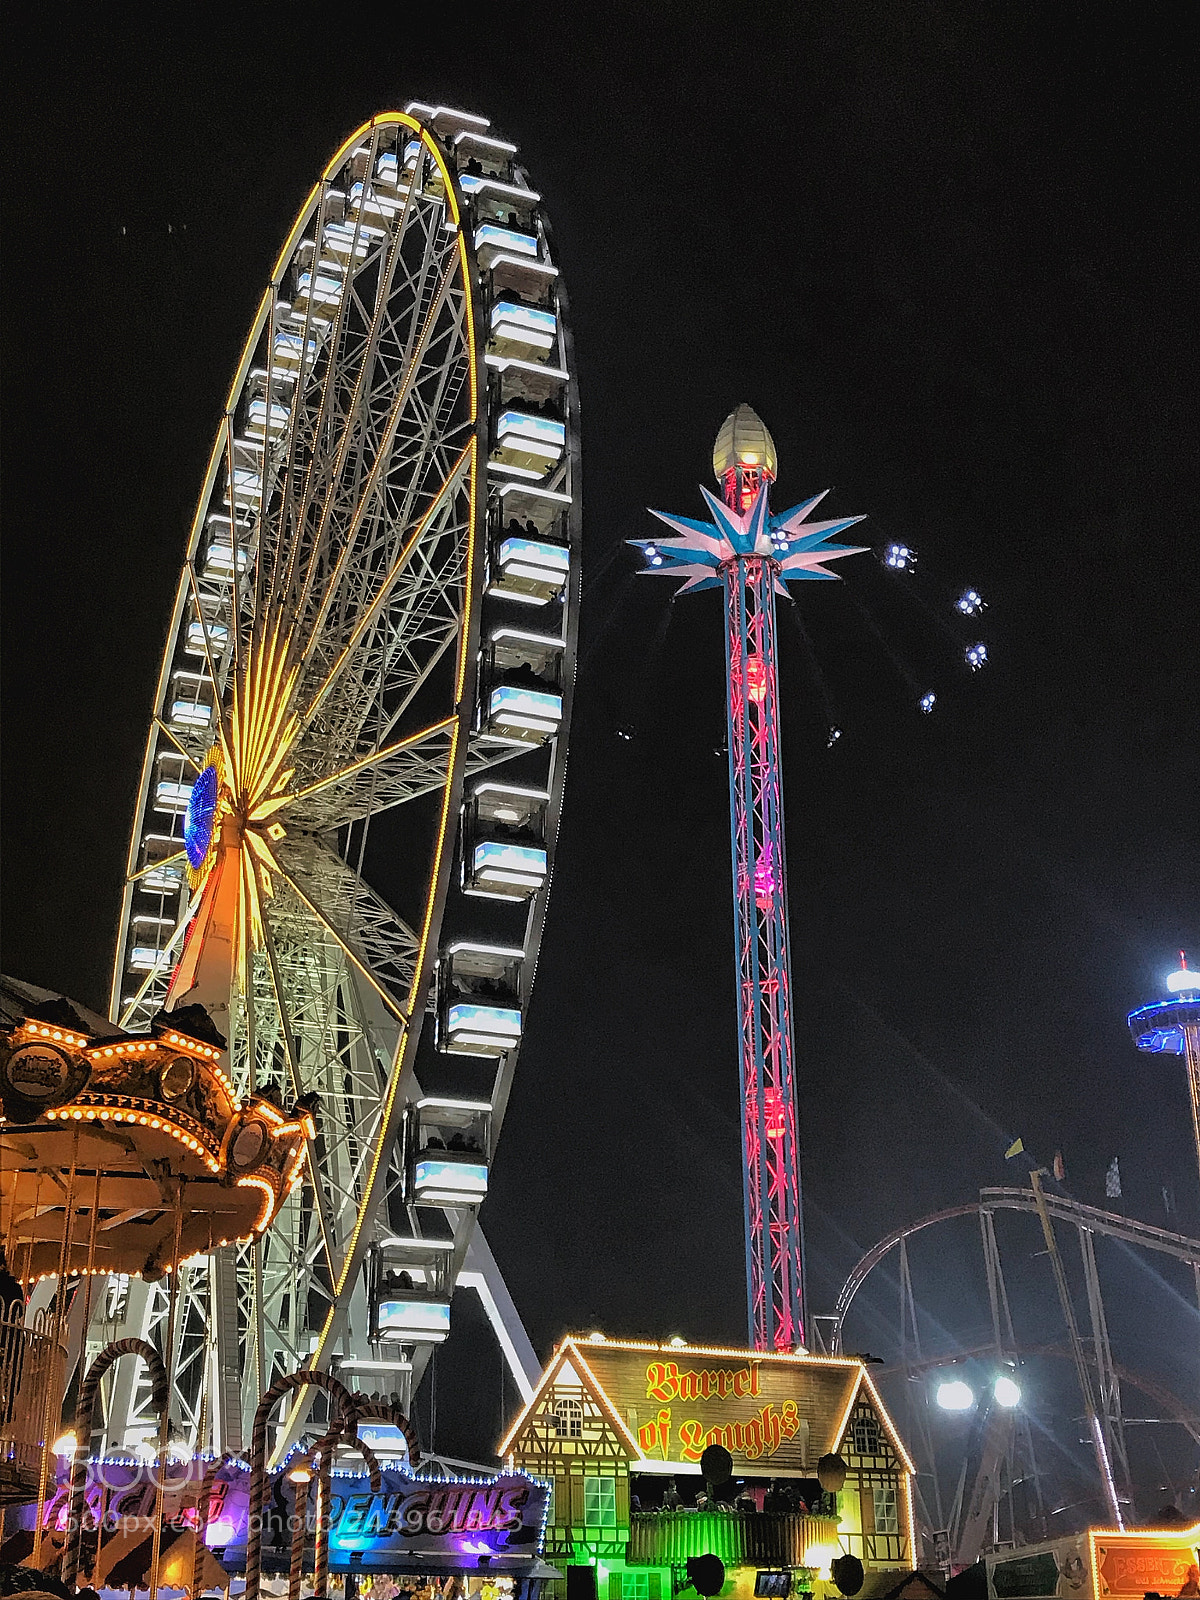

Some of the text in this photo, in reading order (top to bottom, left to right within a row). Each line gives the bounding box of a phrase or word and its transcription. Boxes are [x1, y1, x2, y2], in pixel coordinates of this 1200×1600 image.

[646, 1359, 762, 1403] Barrel
[638, 1399, 800, 1462] of Laughs
[1113, 1557, 1169, 1575] ESSEN
